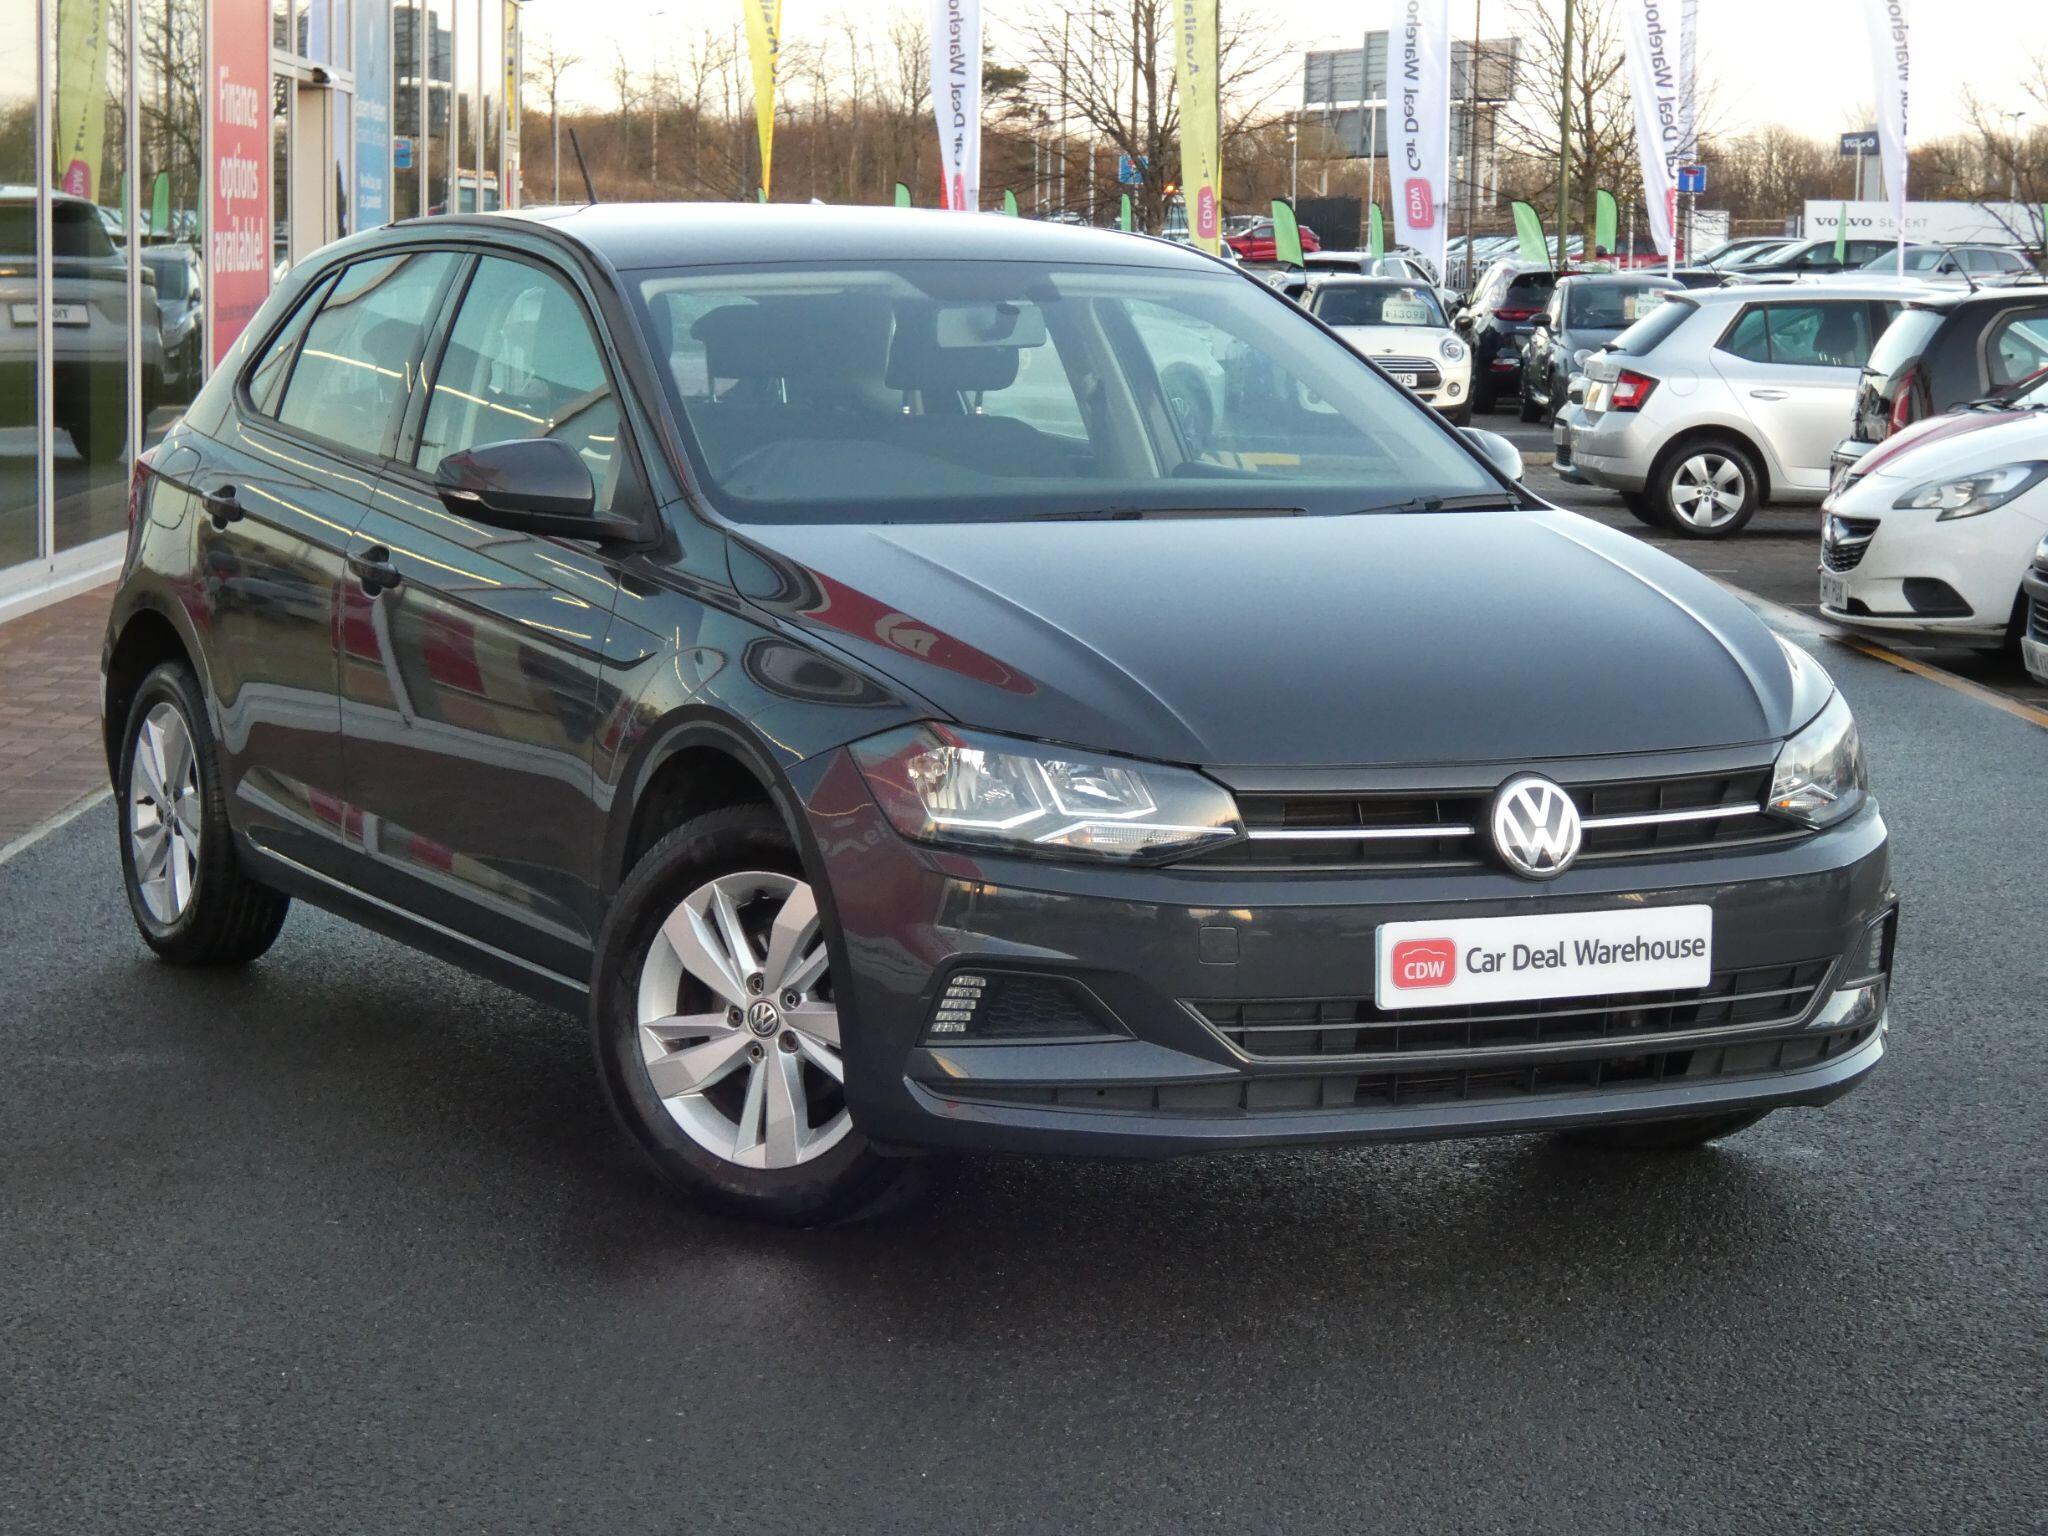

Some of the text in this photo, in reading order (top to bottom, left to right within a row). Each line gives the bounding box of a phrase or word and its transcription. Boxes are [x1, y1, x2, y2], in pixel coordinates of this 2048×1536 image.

[219, 66, 258, 129] Finance
[73, 170, 84, 197] DW
[220, 142, 259, 215] options
[1814, 217, 1928, 228] VOVO SEEKT
[215, 216, 264, 273] available!
[1404, 961, 1445, 980] CDW
[1466, 935, 1706, 974] Car Deal Warehouse
